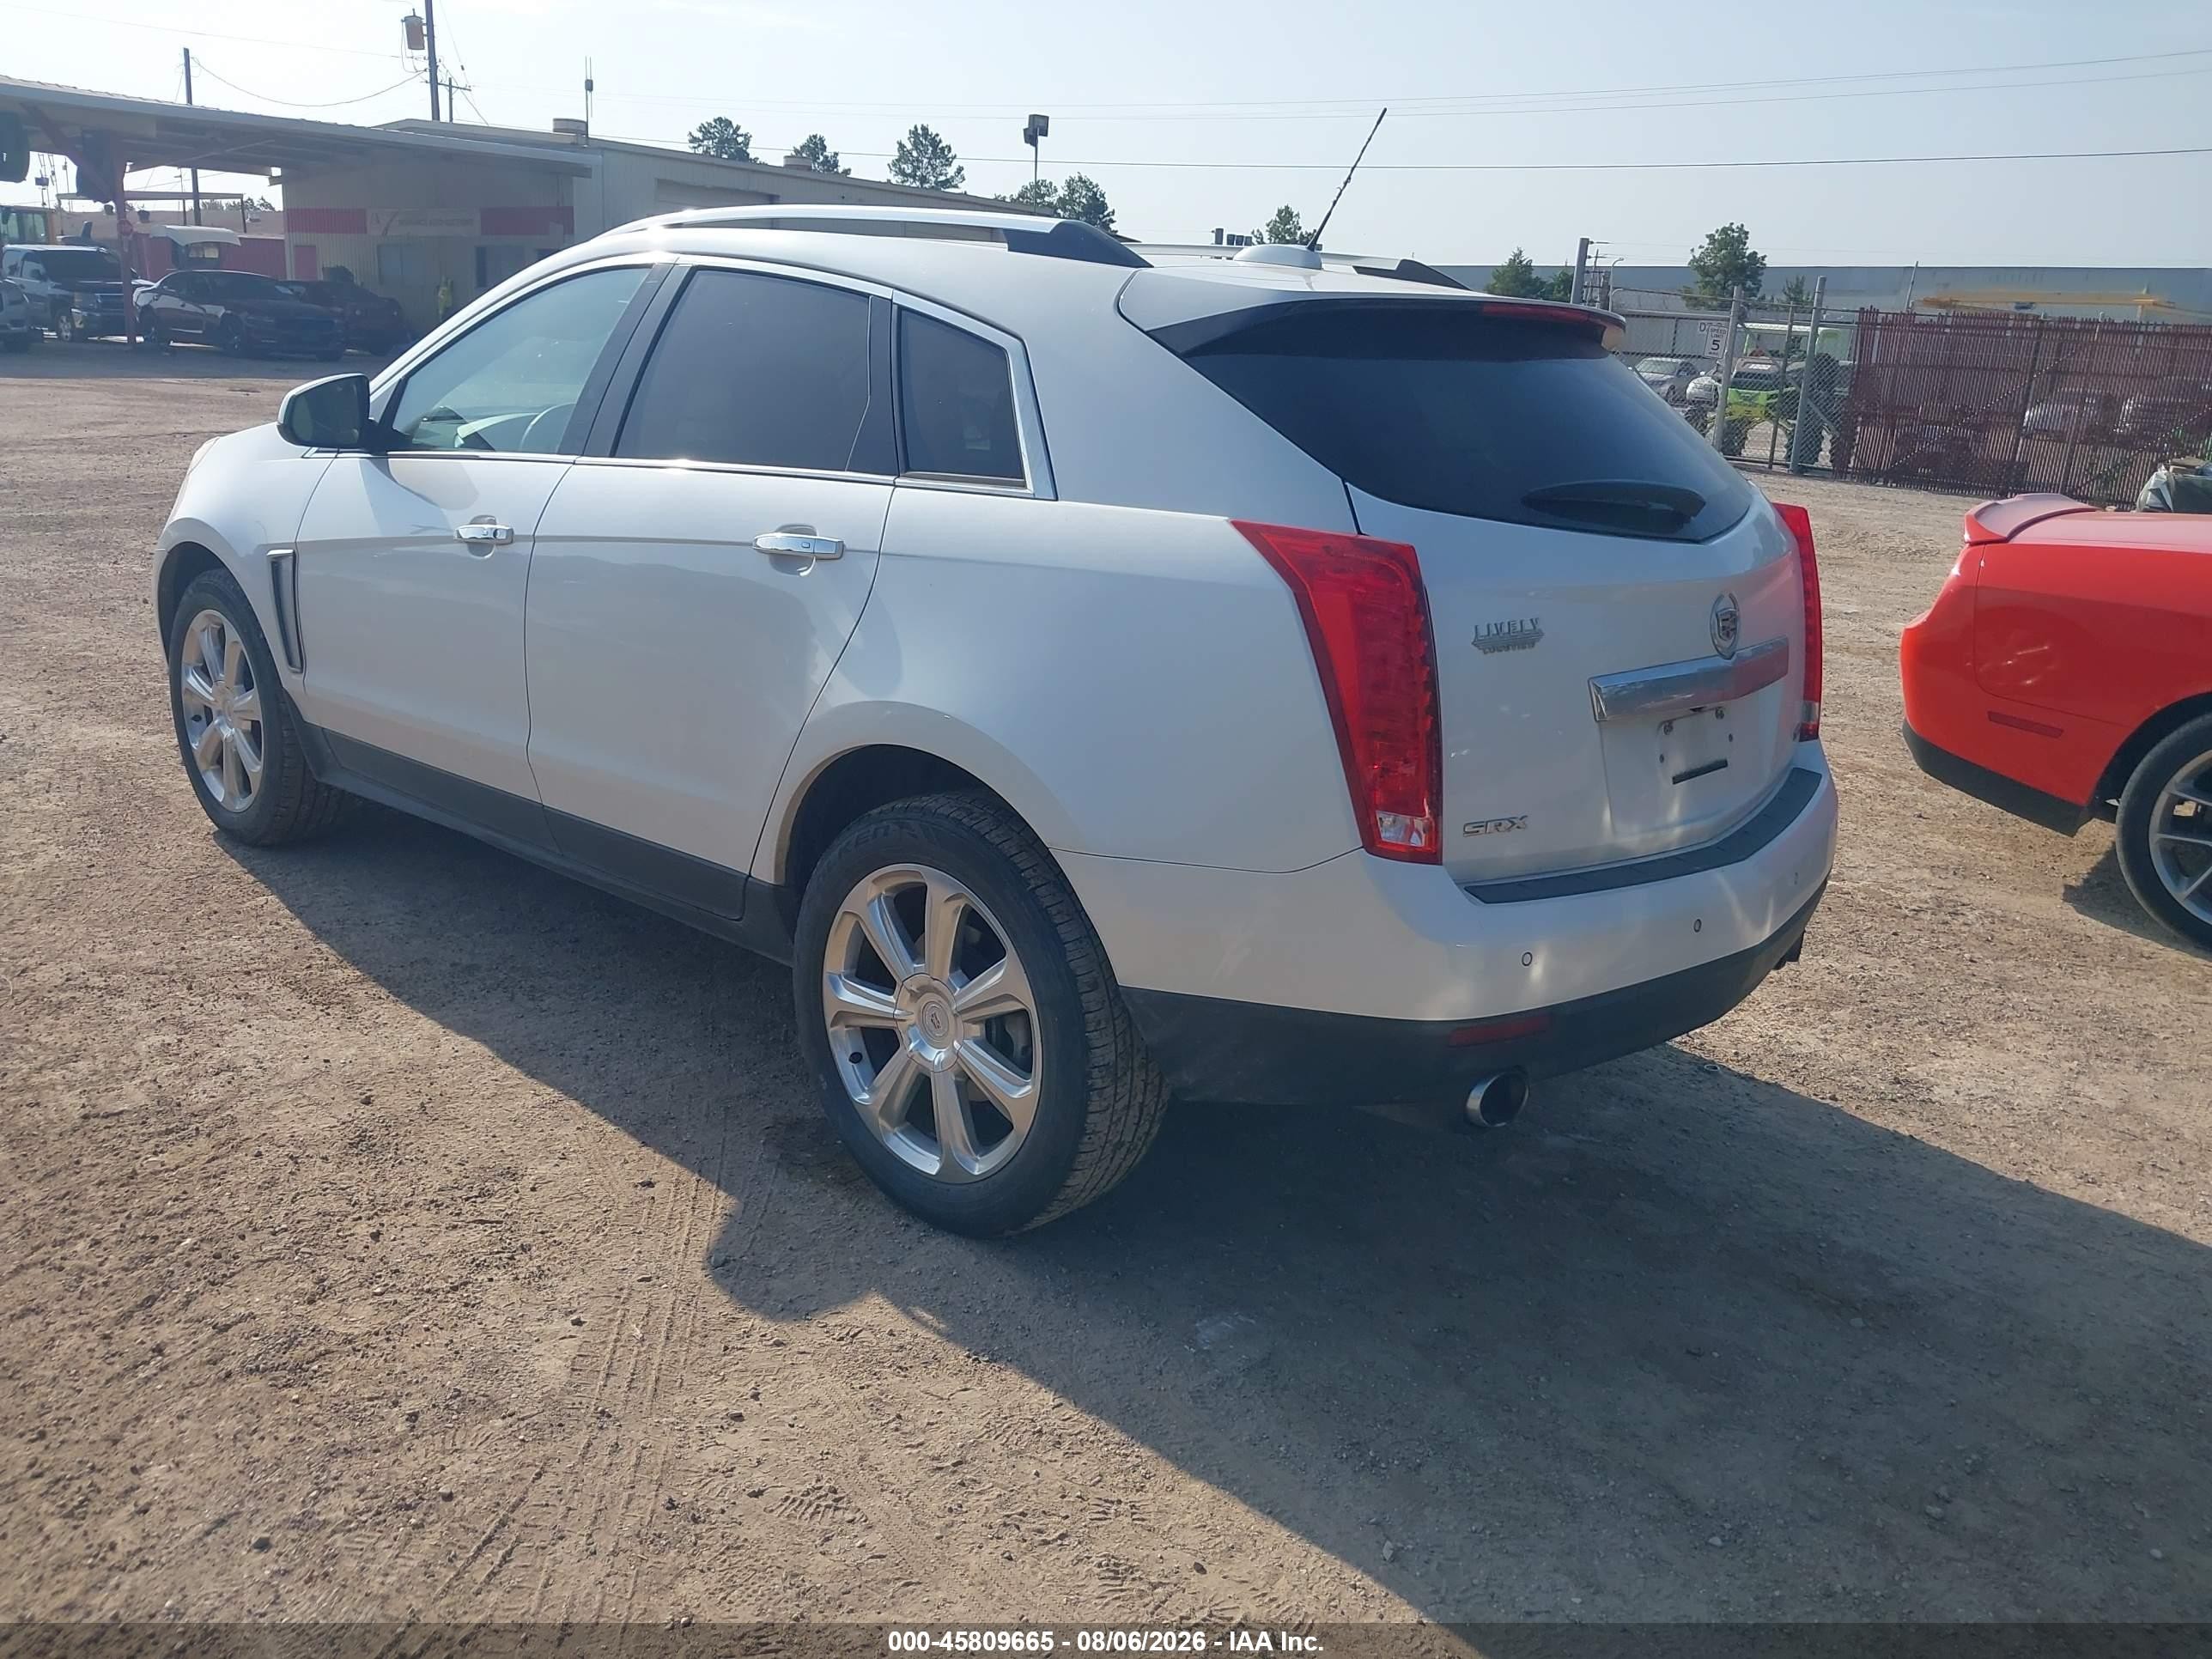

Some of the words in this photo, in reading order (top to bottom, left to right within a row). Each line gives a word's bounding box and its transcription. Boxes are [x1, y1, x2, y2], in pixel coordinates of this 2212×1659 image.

[1711, 339, 1721, 351] 5
[1474, 617, 1540, 639] LIVELY
[1462, 815, 1528, 838] SRX
